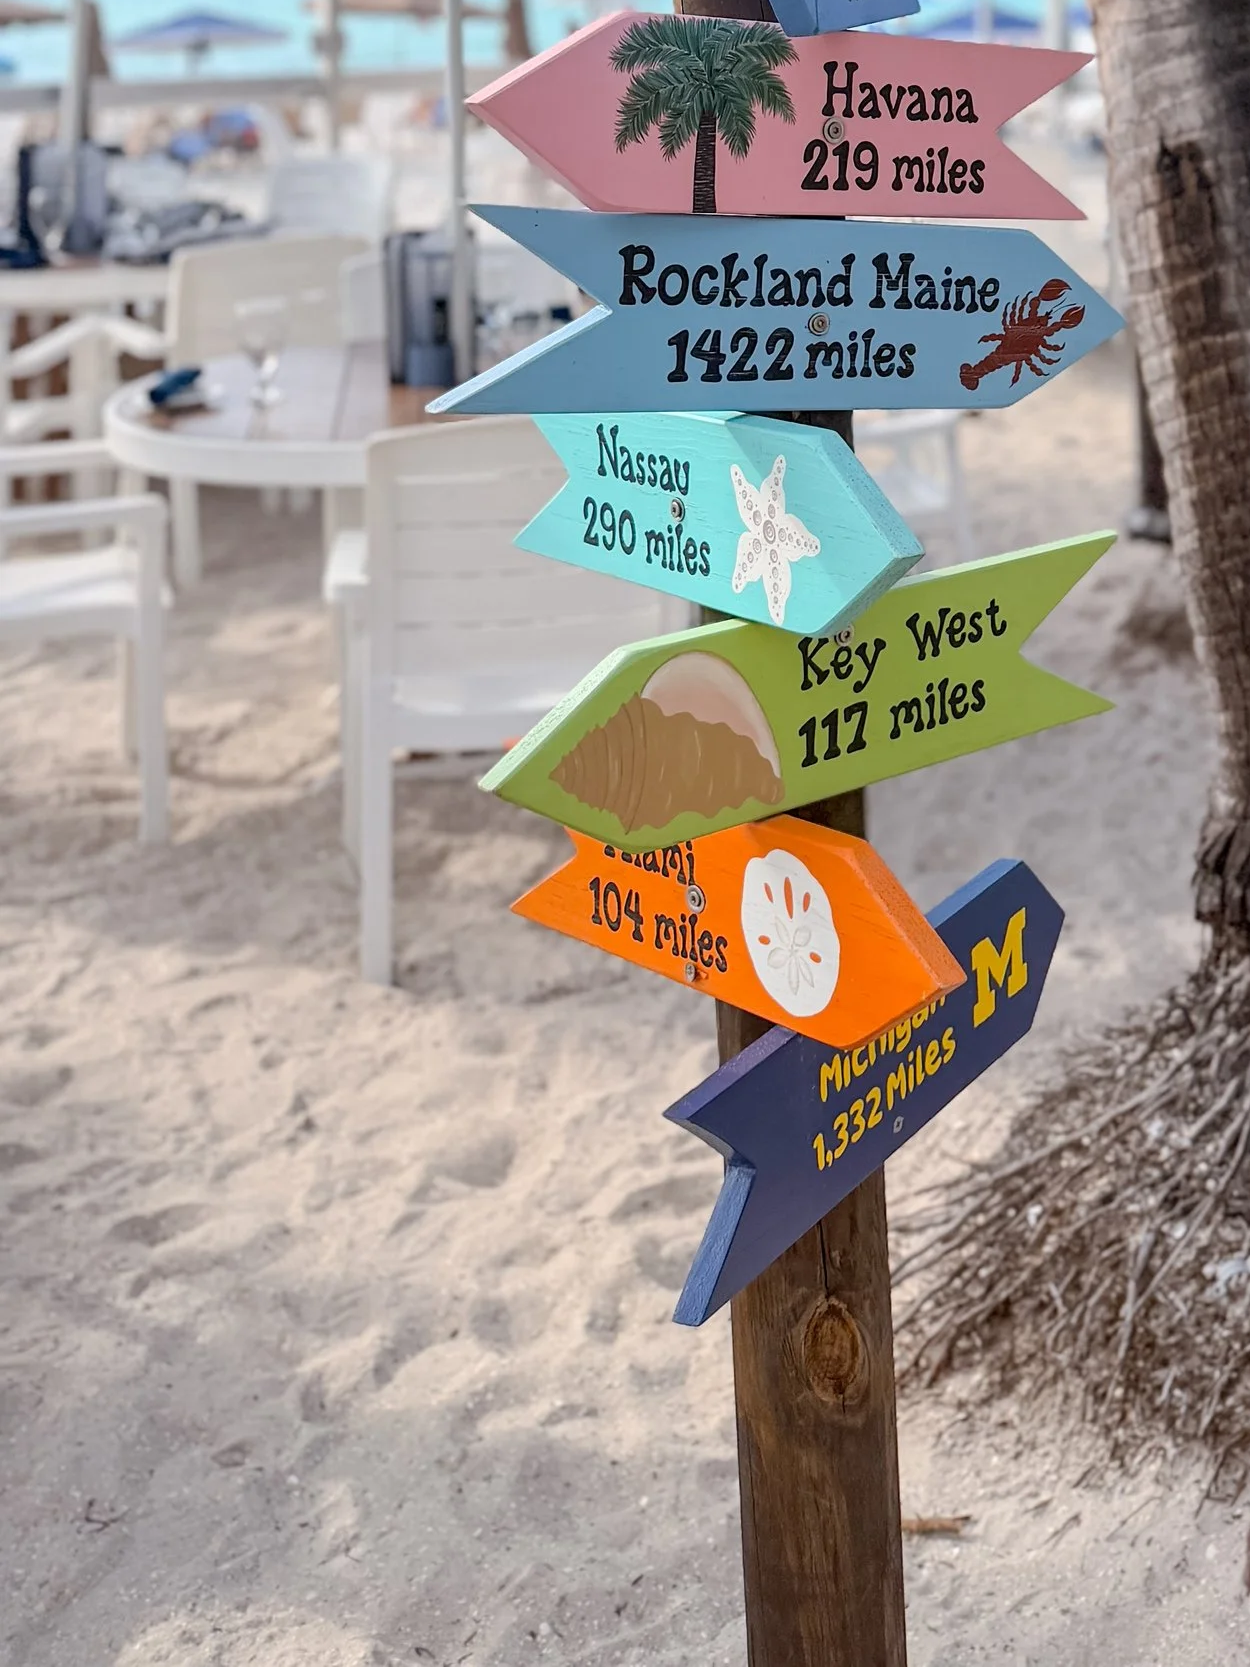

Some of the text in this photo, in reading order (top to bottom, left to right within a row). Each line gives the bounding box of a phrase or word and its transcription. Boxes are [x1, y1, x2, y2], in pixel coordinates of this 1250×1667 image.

[821, 60, 979, 124] Havana
[800, 138, 986, 194] 219 miles
[617, 244, 1000, 314] Rockland Maine
[666, 326, 917, 383] 1422 miles
[596, 422, 691, 496] Nassau
[583, 495, 711, 577] 290 miles
[797, 598, 1008, 693] Key West
[798, 677, 987, 768] 117 miles
[604, 840, 695, 885] ami
[589, 876, 728, 973] 104 miles
[970, 906, 1028, 1028] M
[812, 1026, 957, 1172] 1,332 Miles
